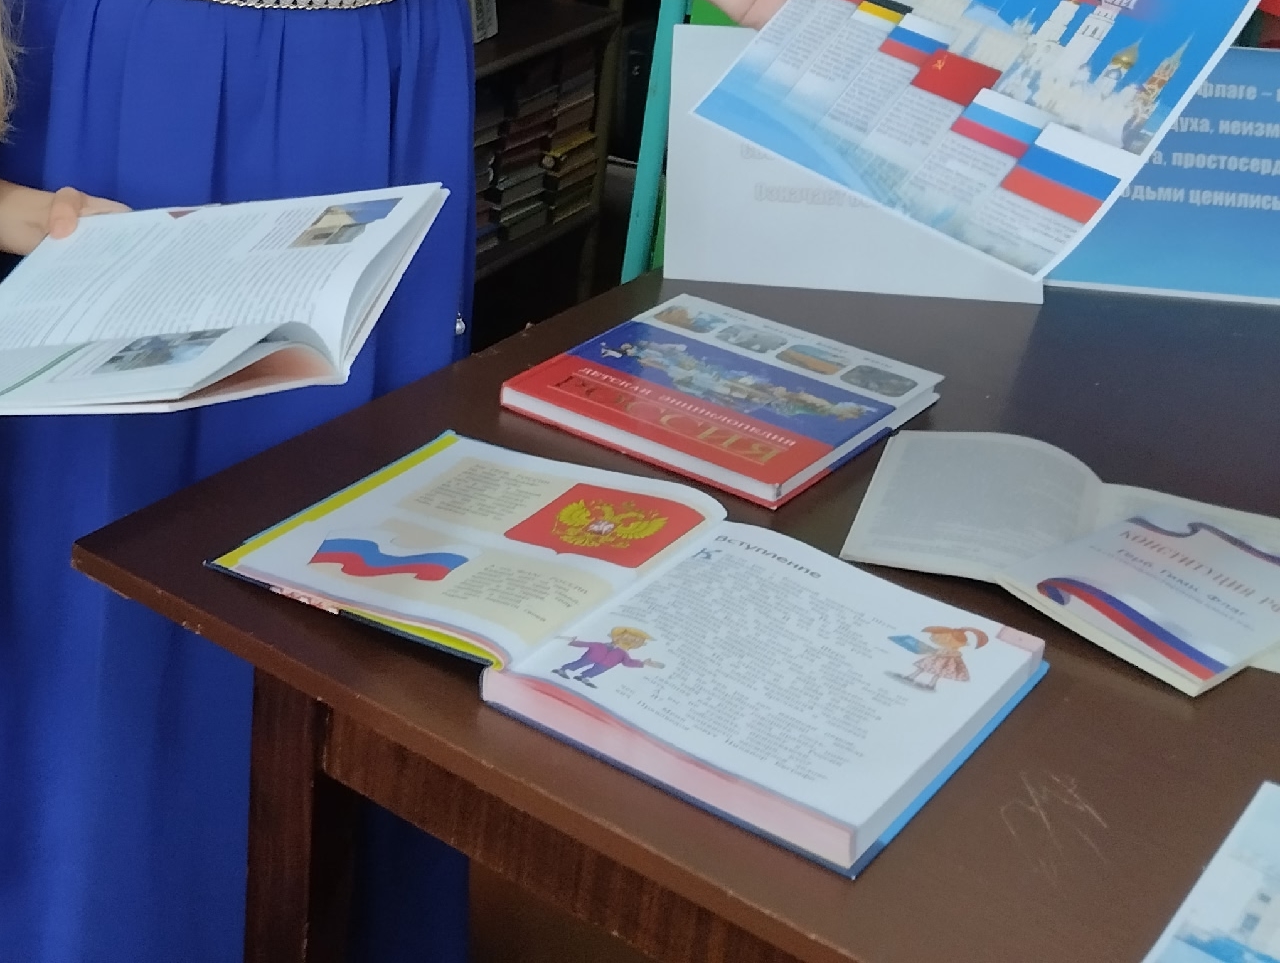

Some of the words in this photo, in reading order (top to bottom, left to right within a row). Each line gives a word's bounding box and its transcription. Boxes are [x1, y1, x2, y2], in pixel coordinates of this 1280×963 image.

[1197, 79, 1257, 101] флаге
[554, 374, 779, 465] РОССИЯ
[578, 365, 653, 397] ДЕТСКАЯ
[657, 392, 798, 448] ЭНЦИКЛОПЕДИЯ
[714, 535, 823, 580] Вступление
[1120, 529, 1257, 599] КОНСТИТУЦИЯ
